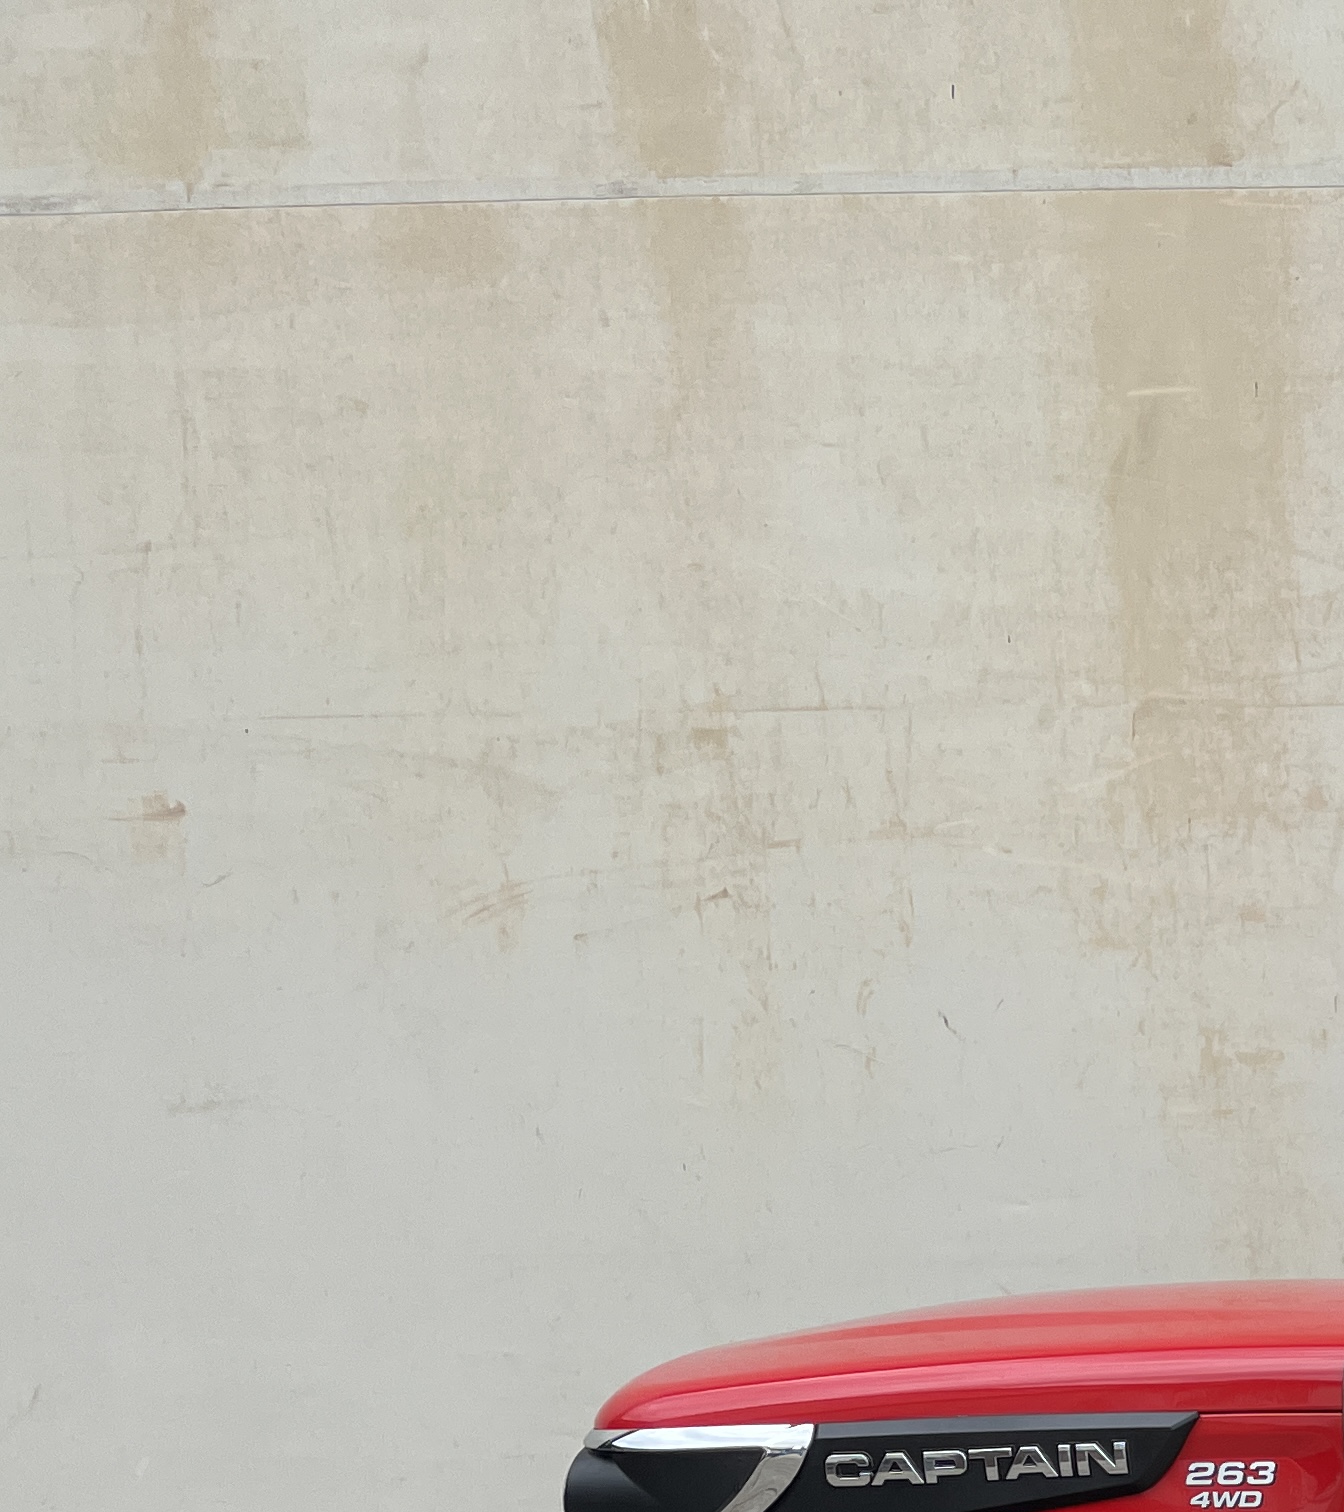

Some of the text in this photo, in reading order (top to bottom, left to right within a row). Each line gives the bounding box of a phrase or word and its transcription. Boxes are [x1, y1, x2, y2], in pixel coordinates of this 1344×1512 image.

[824, 1441, 1129, 1488] CAPTAIN
[1185, 1461, 1275, 1487] 263
[1190, 1490, 1263, 1509] 4WD
